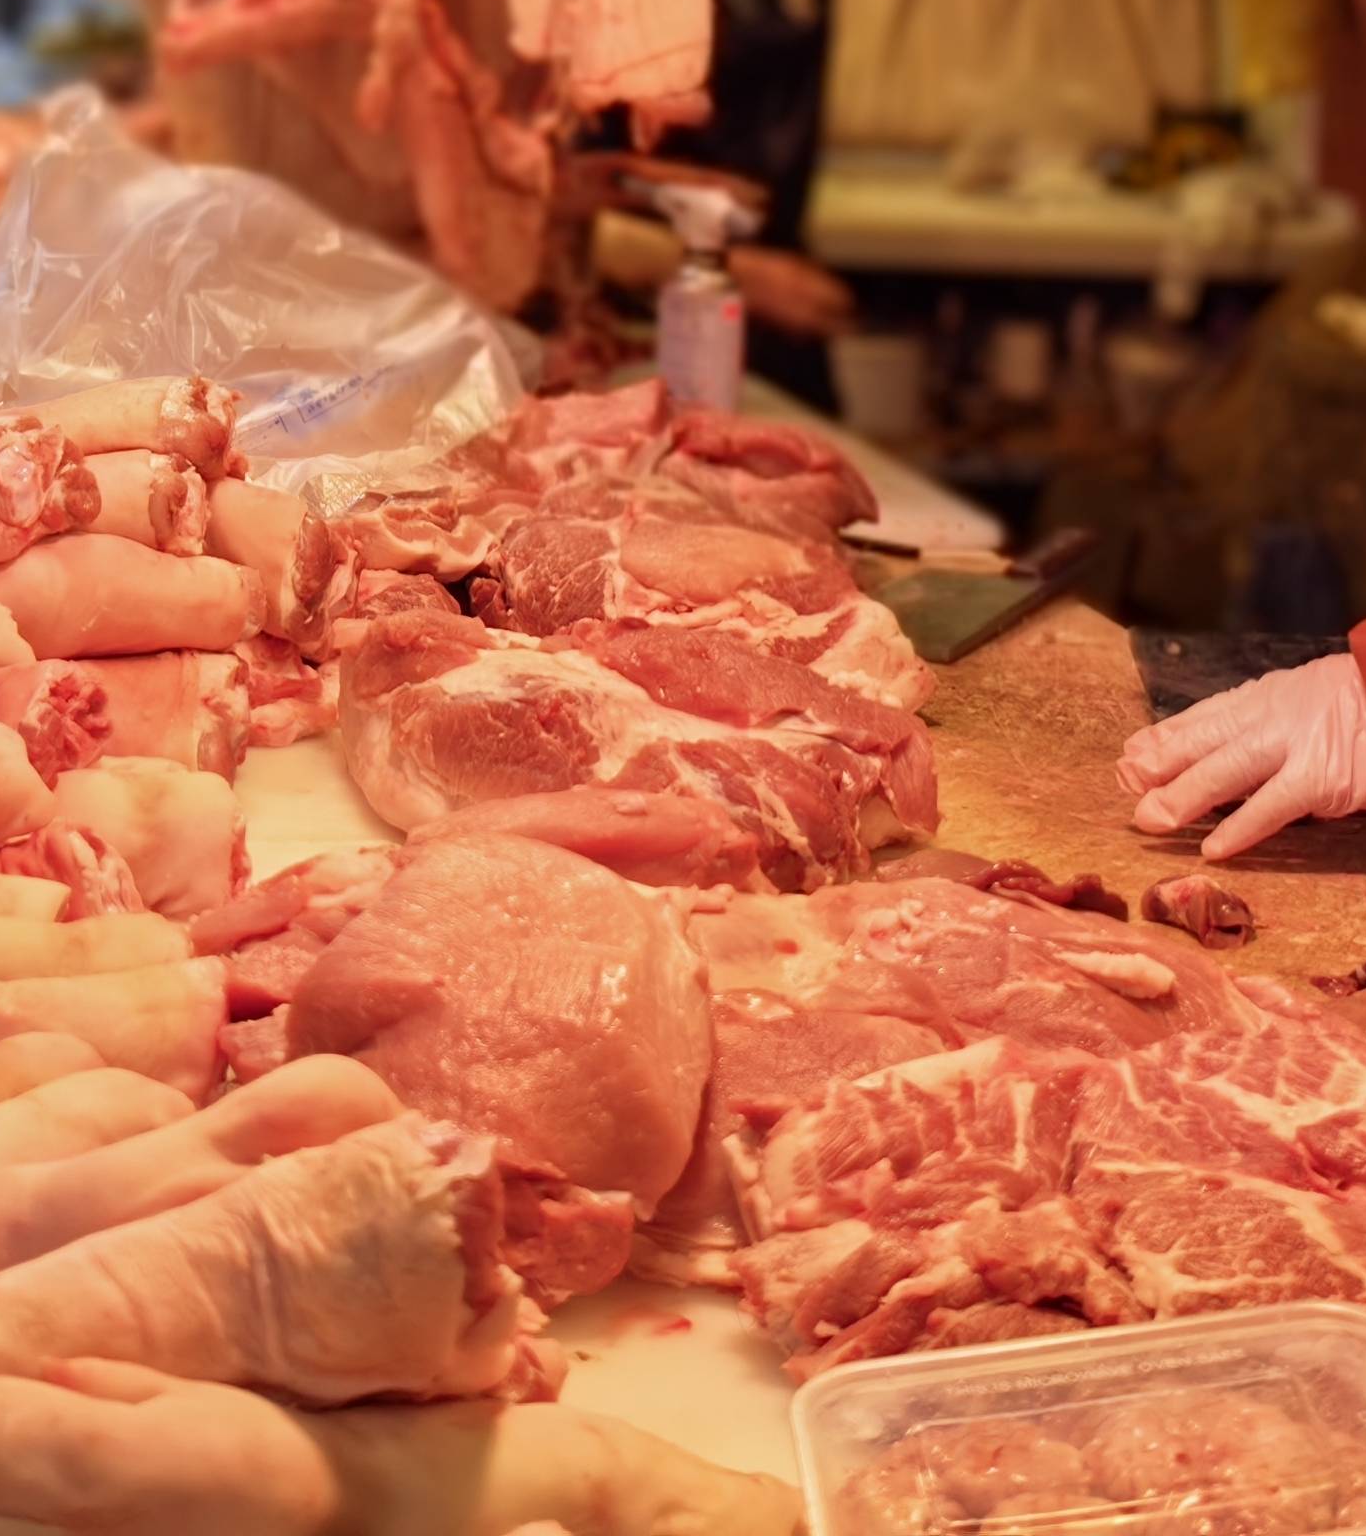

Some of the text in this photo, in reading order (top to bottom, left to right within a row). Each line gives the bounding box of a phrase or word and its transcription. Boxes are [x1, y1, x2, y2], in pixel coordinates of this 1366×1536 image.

[1015, 1364, 1132, 1390] MICROWAVE
[1137, 1357, 1193, 1373] OVEN
[1195, 1348, 1244, 1365] SAFE
